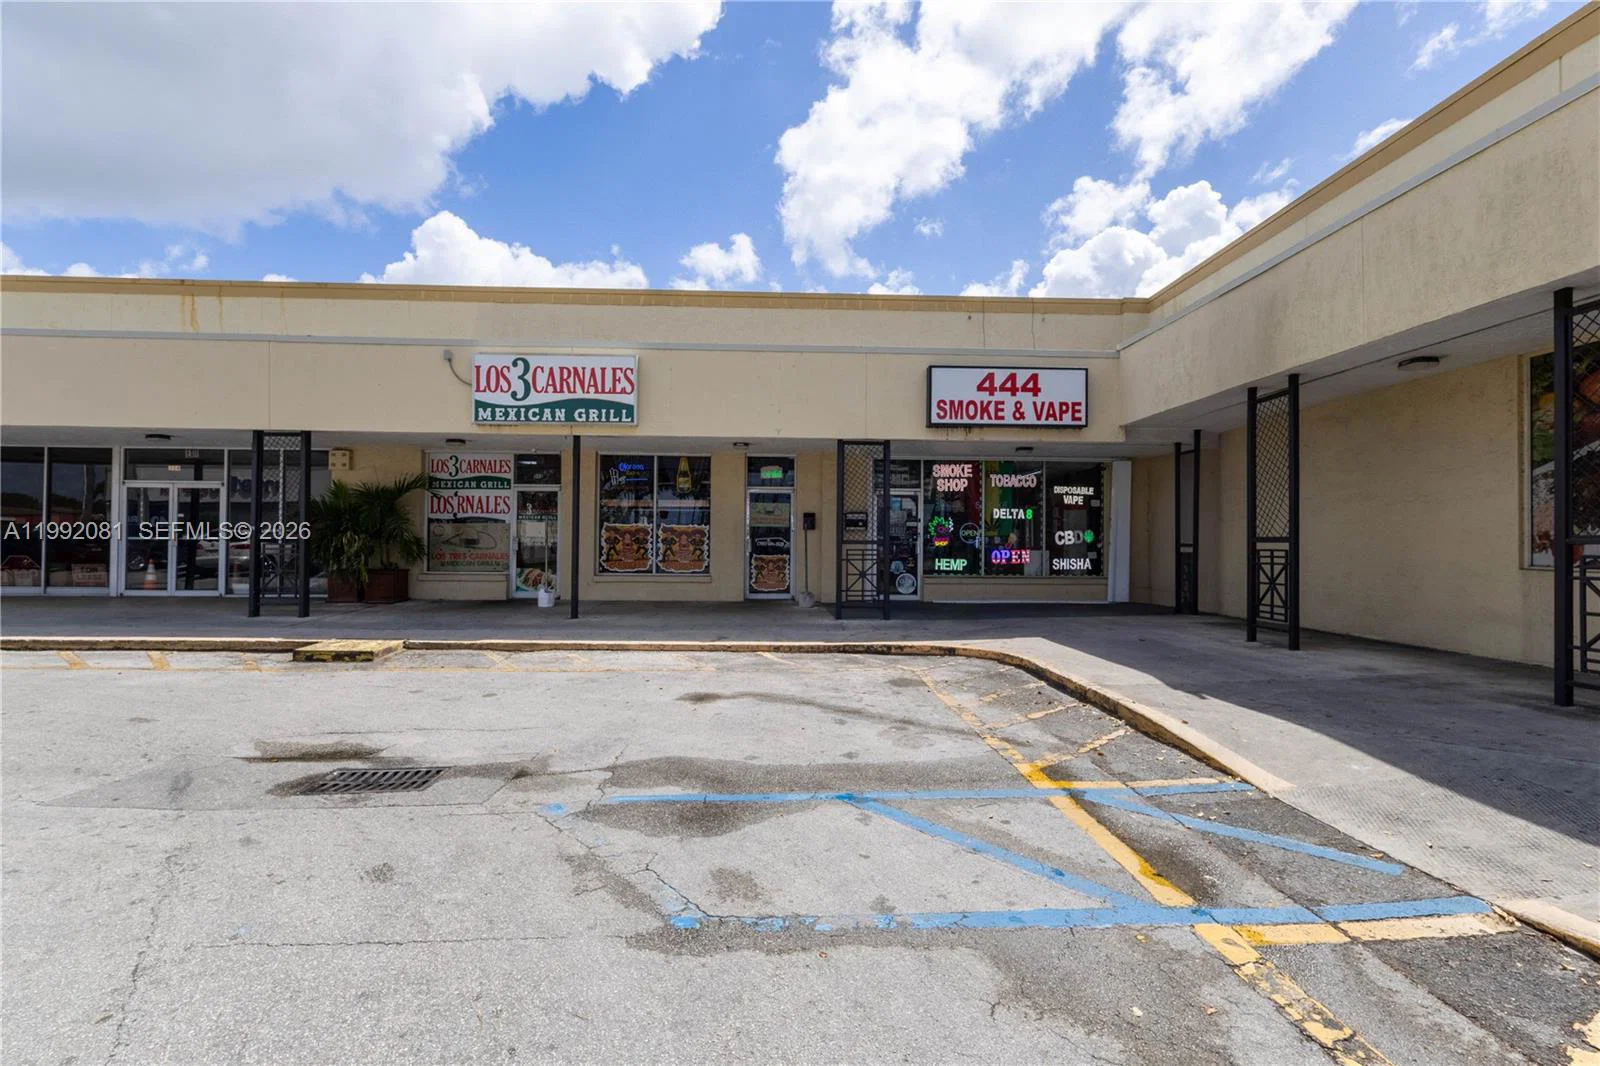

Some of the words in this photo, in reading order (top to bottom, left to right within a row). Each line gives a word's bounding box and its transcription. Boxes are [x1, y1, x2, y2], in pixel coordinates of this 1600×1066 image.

[474, 365, 511, 393] LOS
[511, 357, 531, 401] 3
[531, 366, 635, 395] CARNALES
[976, 372, 1041, 397] 444
[477, 407, 565, 422] MEXICAN
[574, 408, 632, 423] GRILL
[936, 399, 1005, 421] SMOKE
[1012, 400, 1026, 421] &
[1033, 401, 1082, 422] VAPE
[431, 459, 448, 474] LOS
[449, 455, 459, 477] 3
[459, 459, 511, 474] CARNALES
[932, 463, 973, 478] SMOKE
[432, 480, 477, 489] MEXICAN
[480, 480, 510, 489] GRILL
[936, 478, 968, 492] SHOP
[990, 474, 1037, 488] TOBACCO
[1053, 485, 1094, 496] DISPOSABLE
[430, 496, 453, 514] LOS
[1063, 495, 1084, 505] VAPE
[993, 508, 1025, 519] DELTA
[1025, 508, 1034, 520] 8
[1055, 530, 1084, 546] CBD
[935, 558, 968, 570] HEMP
[991, 549, 1031, 564] OPEN
[1052, 557, 1092, 570] SHISHA
